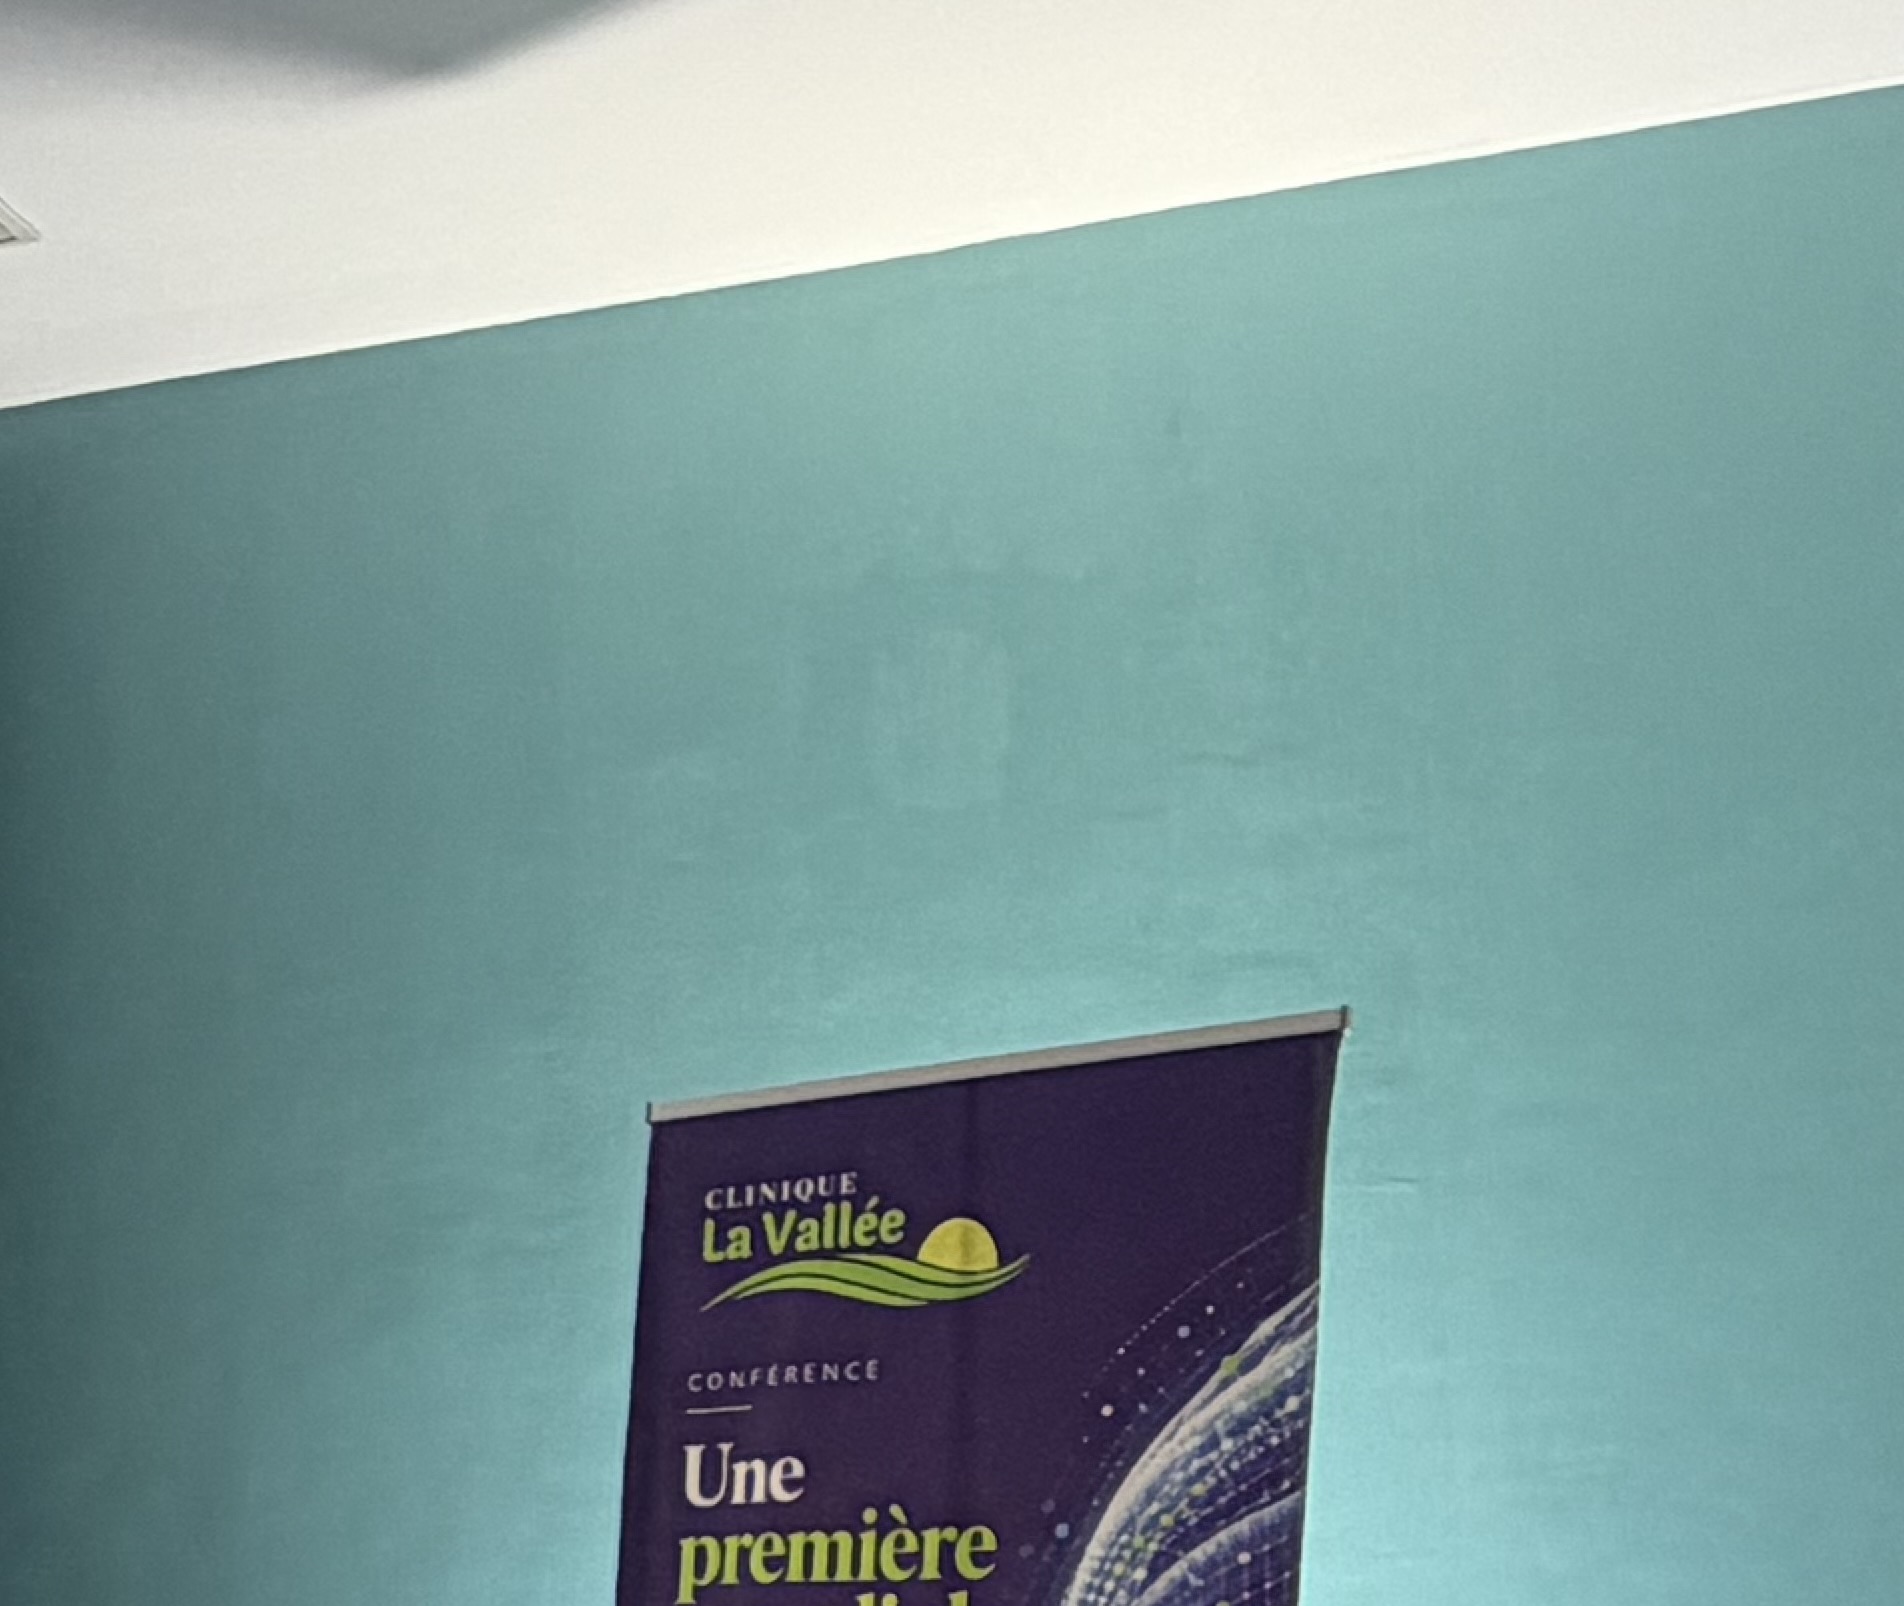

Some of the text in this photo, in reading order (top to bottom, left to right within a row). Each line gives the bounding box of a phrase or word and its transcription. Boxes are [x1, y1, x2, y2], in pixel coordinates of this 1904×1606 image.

[704, 1171, 858, 1211] CLINIQUE
[703, 1195, 906, 1262] La Vallée
[686, 1359, 881, 1393] CONFÉRENCE
[683, 1442, 806, 1508] Une
[675, 1503, 999, 1606] première
